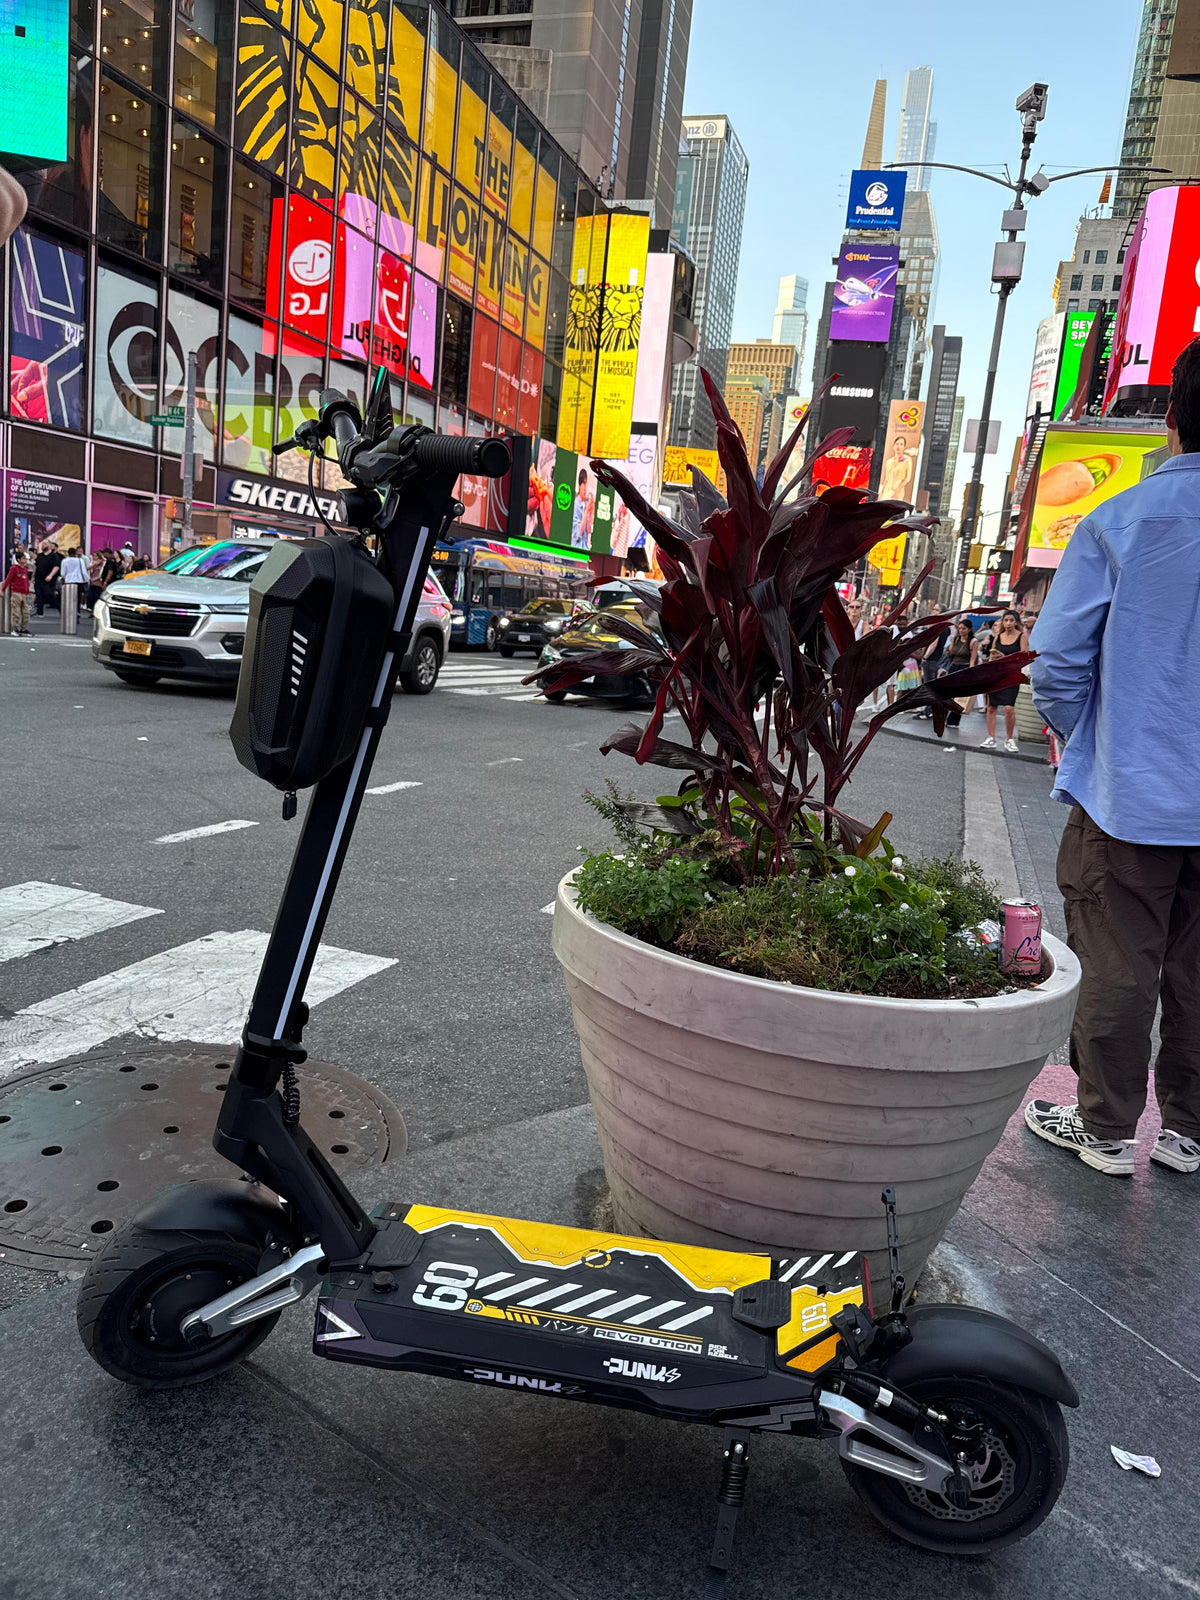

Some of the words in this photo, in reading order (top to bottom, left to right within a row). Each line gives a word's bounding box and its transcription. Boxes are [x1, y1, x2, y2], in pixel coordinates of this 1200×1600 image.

[474, 135, 508, 202] THE
[856, 206, 894, 216] Prudential
[426, 150, 488, 265] LION
[489, 209, 542, 307] KING
[613, 360, 634, 368] WORLD'S
[608, 367, 634, 377] MUSICAL
[830, 386, 874, 398] SAMSUNG
[11, 478, 22, 486] THE
[23, 480, 62, 492] OPPORTUNITY
[25, 487, 49, 497] LIFETIME
[229, 479, 342, 522] SKECHER
[412, 1261, 479, 1311] 60
[801, 1302, 828, 1332] 60
[543, 1320, 588, 1334] パンク
[709, 1343, 728, 1351] RIDE
[708, 1352, 739, 1361] REBELS
